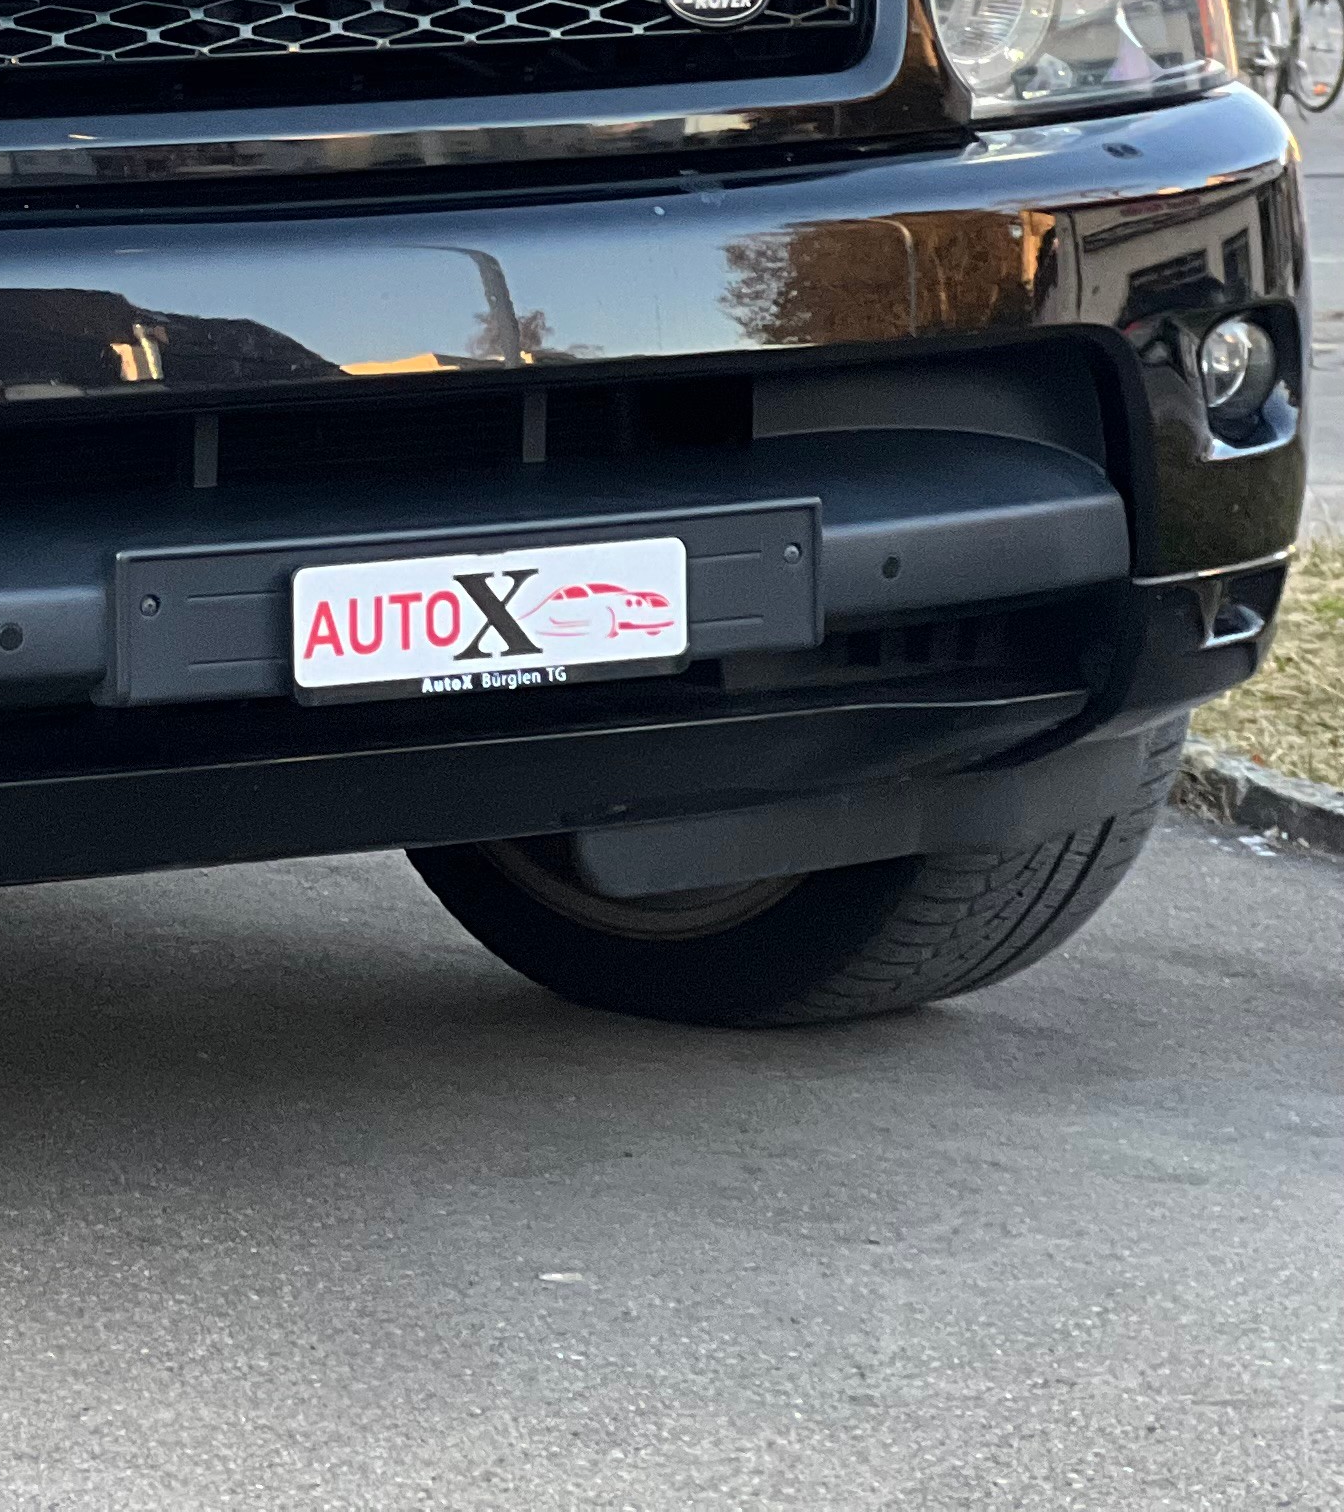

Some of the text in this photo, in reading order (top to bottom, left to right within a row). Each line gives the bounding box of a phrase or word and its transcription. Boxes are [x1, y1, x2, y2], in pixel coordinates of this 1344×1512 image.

[421, 666, 568, 694] AutoX Bürglen TG
